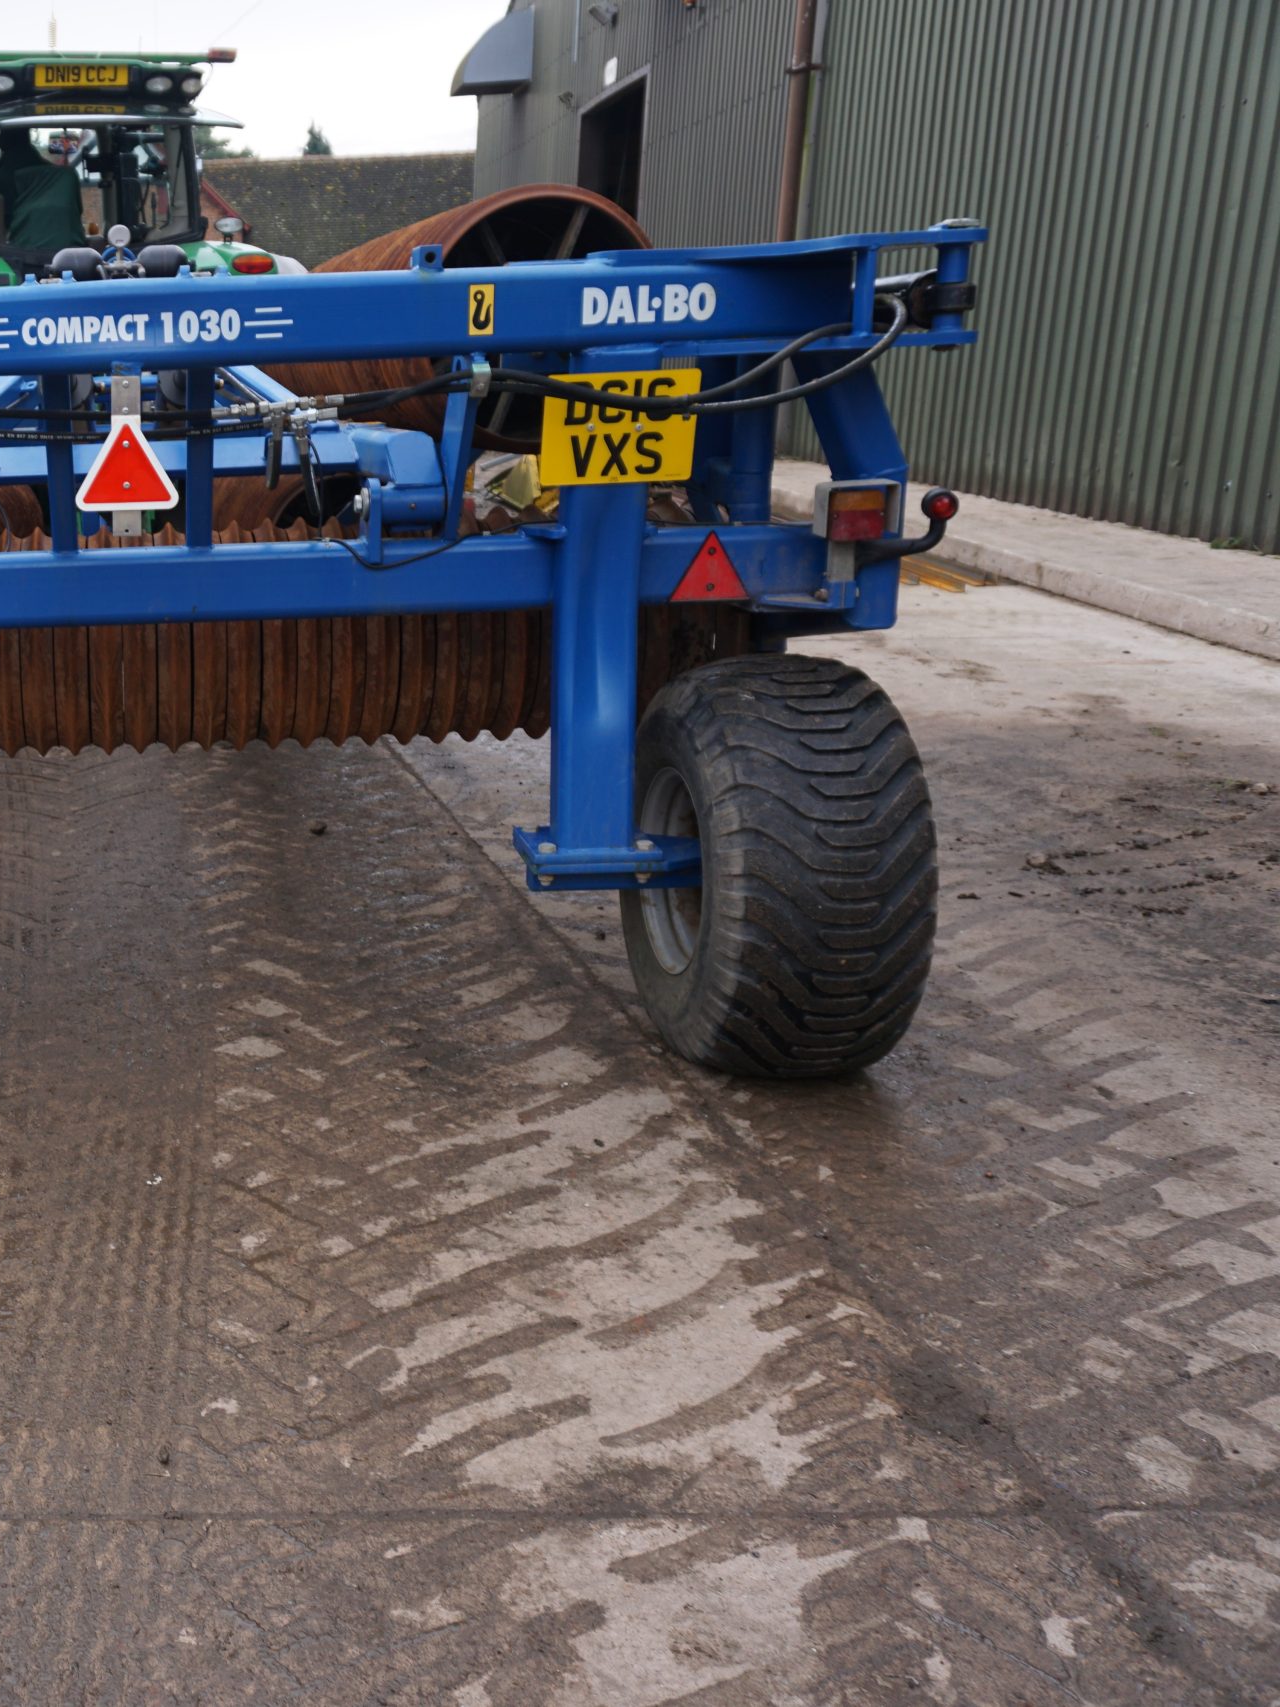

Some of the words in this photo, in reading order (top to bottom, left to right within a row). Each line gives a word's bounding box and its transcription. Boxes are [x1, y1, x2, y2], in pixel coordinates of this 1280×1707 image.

[45, 65, 81, 83] DN19
[86, 65, 118, 82] CCJ
[21, 314, 149, 346] COMPACT
[160, 308, 241, 343] 1030
[570, 431, 664, 478] VXS
